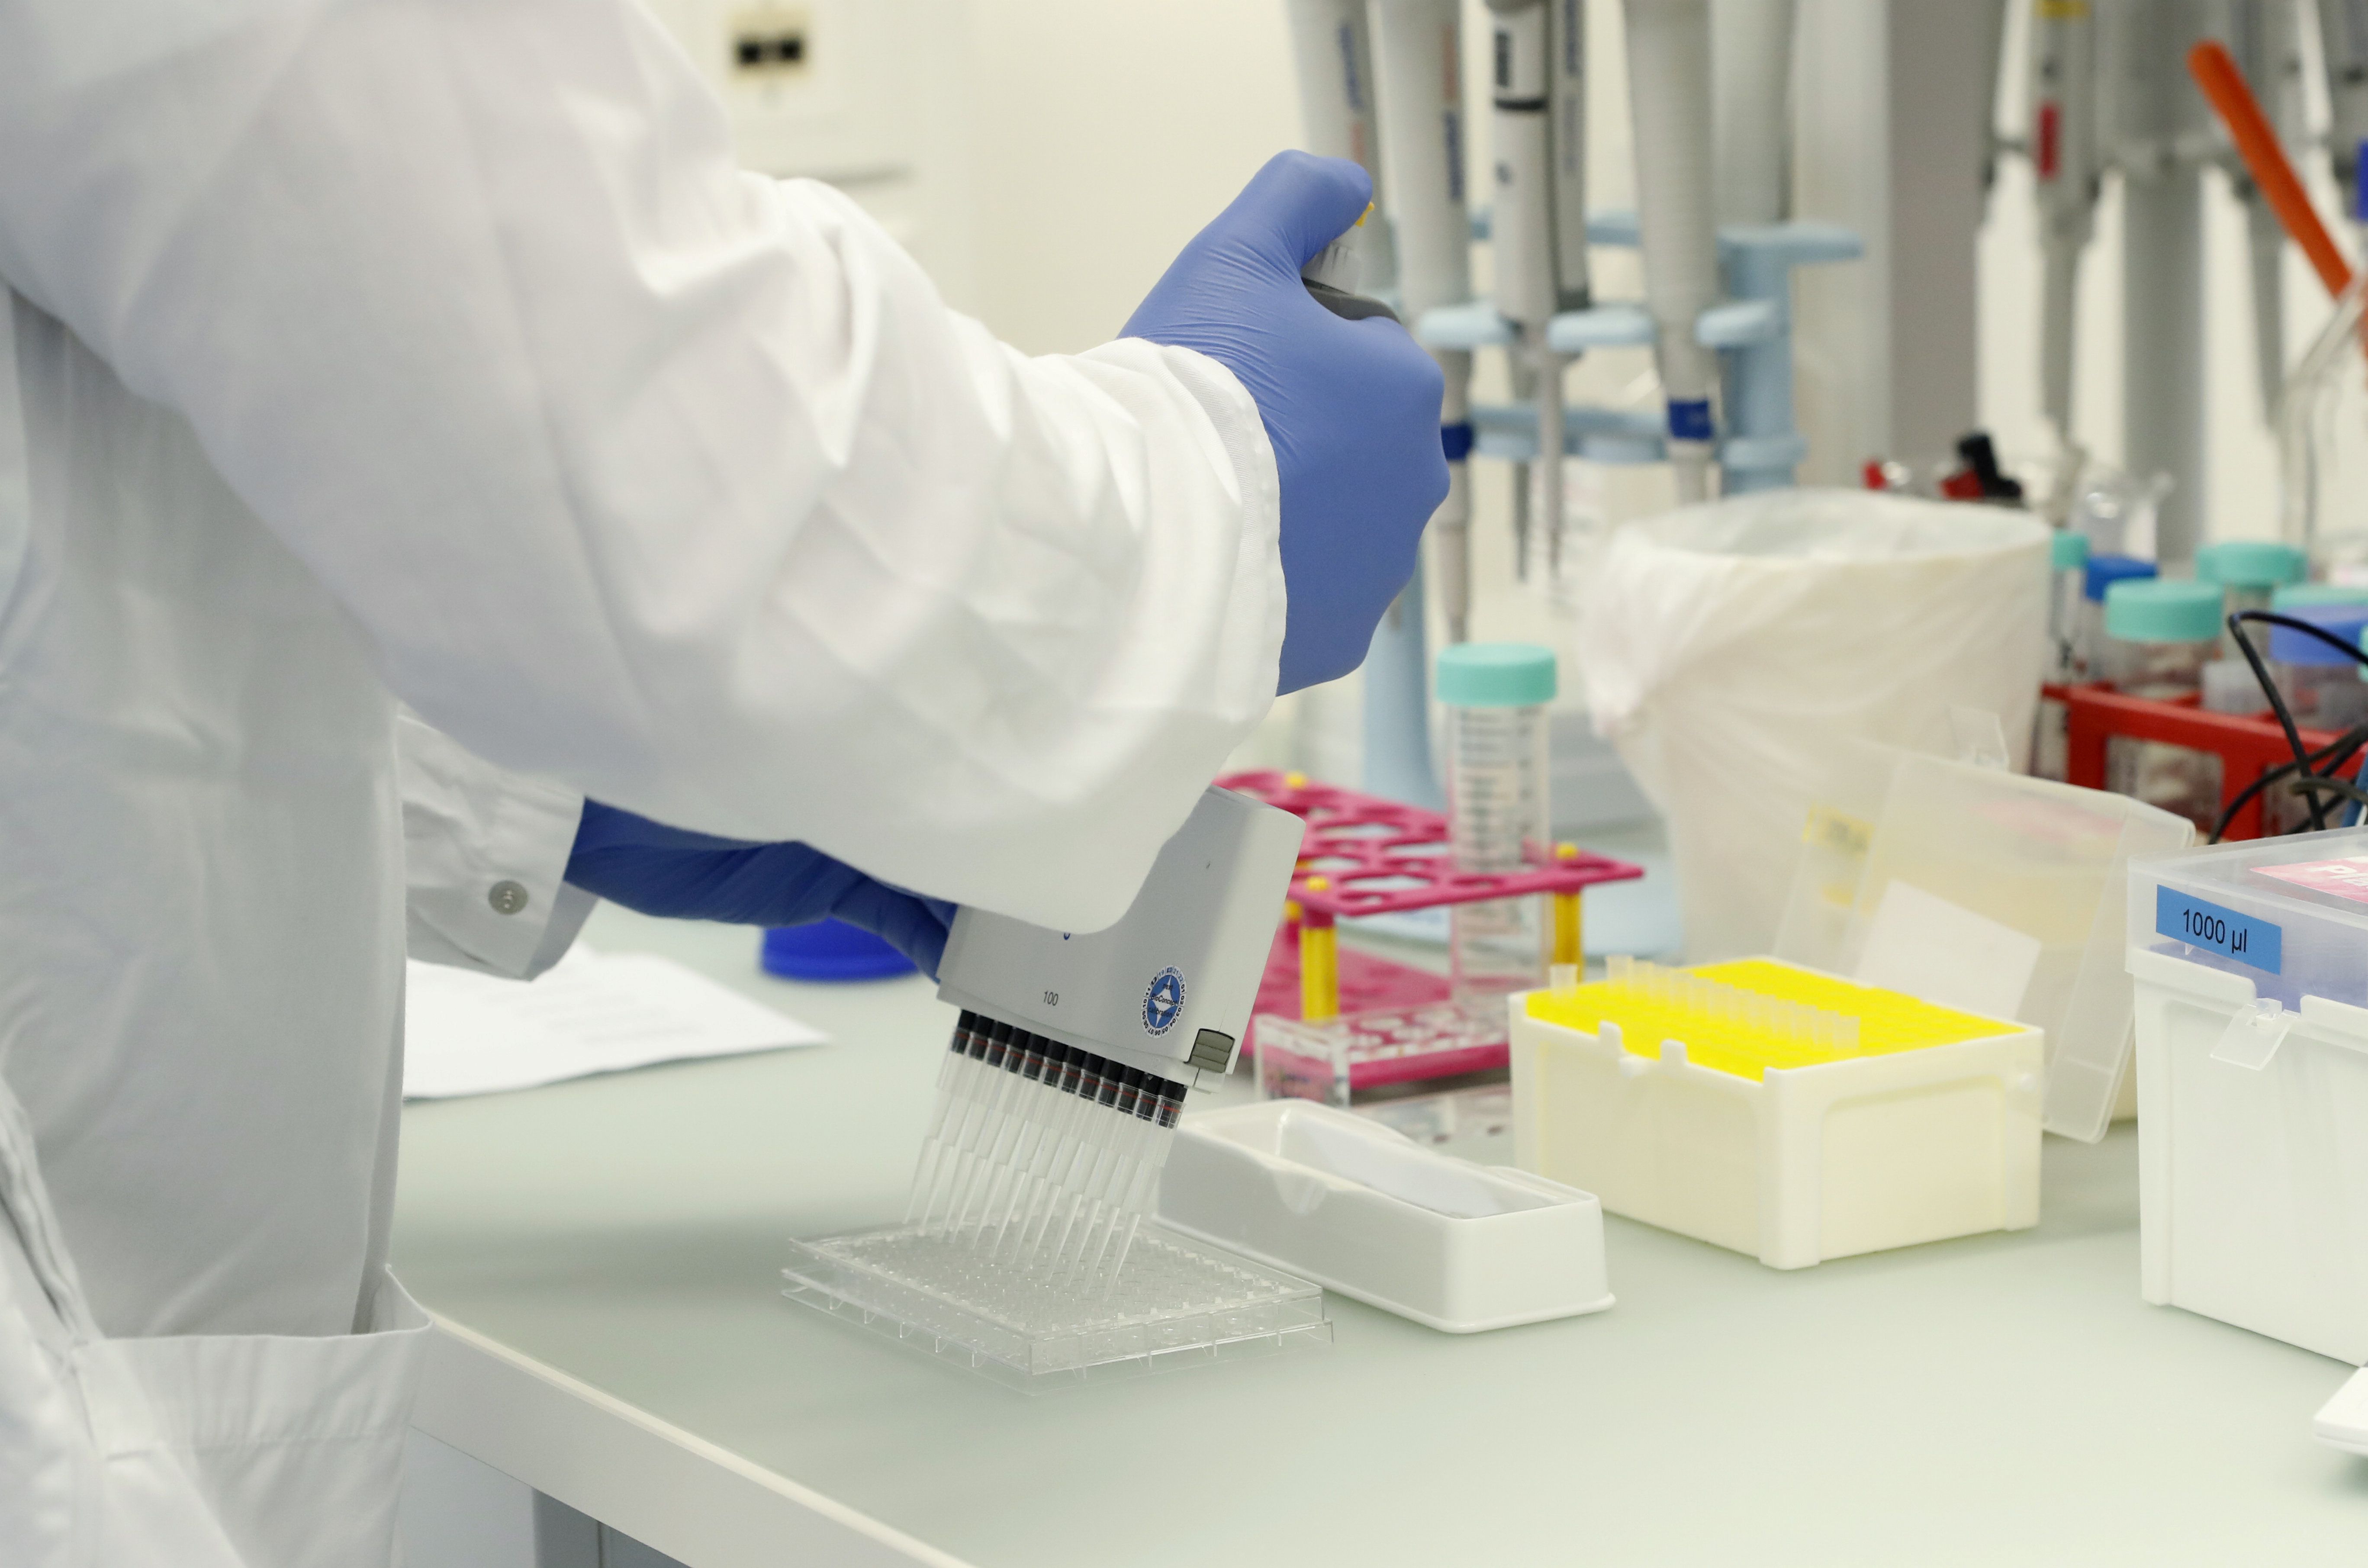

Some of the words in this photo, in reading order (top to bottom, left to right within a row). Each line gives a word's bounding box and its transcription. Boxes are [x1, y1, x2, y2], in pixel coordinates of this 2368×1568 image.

[2305, 865, 2368, 890] Pla
[2183, 909, 2225, 944] 1000
[2232, 928, 2247, 954] µl
[1145, 988, 1151, 996] 11
[1162, 983, 1173, 992] next
[1181, 984, 1185, 993] 01
[1043, 990, 1059, 1006] 100
[1151, 993, 1178, 1006] BioConcept
[1180, 995, 1184, 1005] 02
[1148, 1007, 1173, 1019] calibration
[1176, 1007, 1181, 1017] 03
[1170, 1018, 1176, 1027] 04
